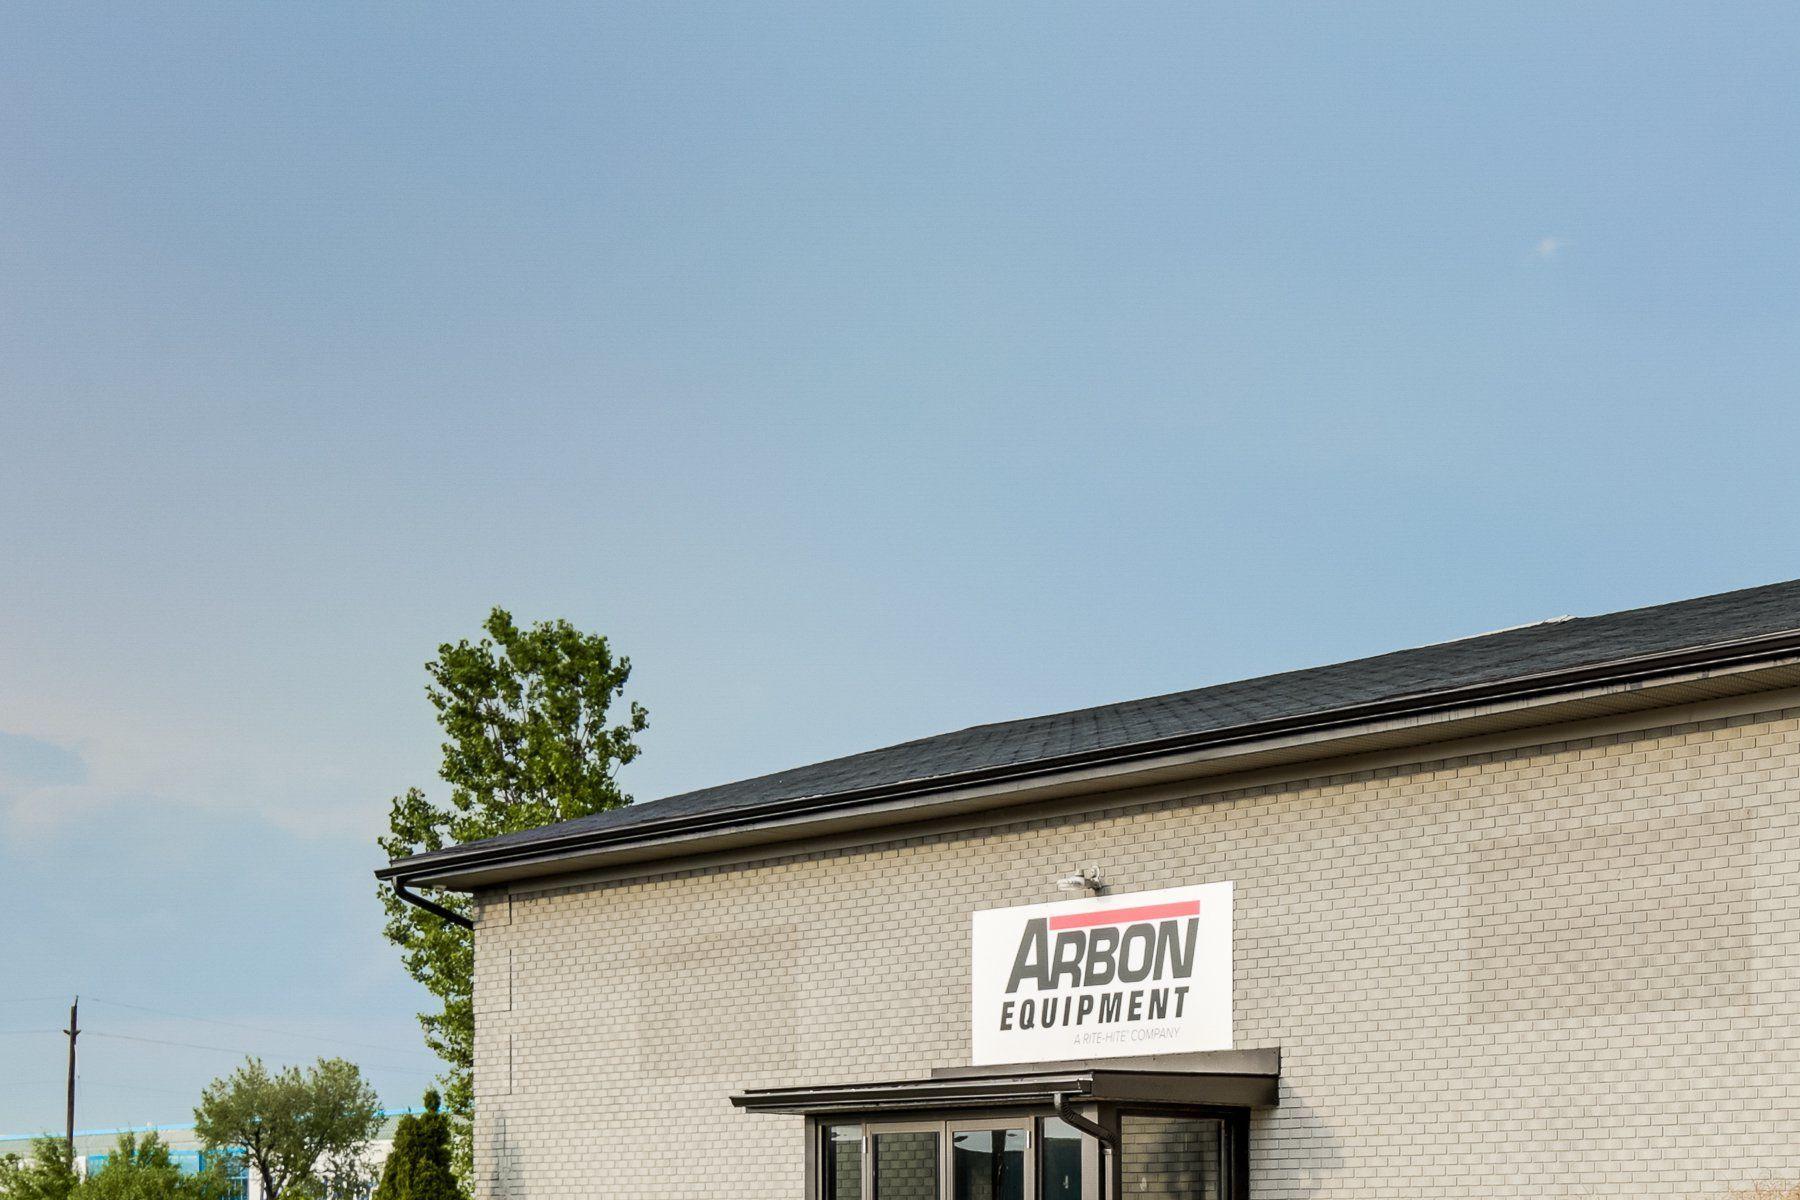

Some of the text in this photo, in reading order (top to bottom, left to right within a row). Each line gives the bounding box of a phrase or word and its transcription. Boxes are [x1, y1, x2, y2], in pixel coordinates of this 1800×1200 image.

[1005, 917, 1200, 994] ARBON
[1000, 986, 1190, 1032] EQUIPMENT
[1131, 1027, 1180, 1042] COMPANY
